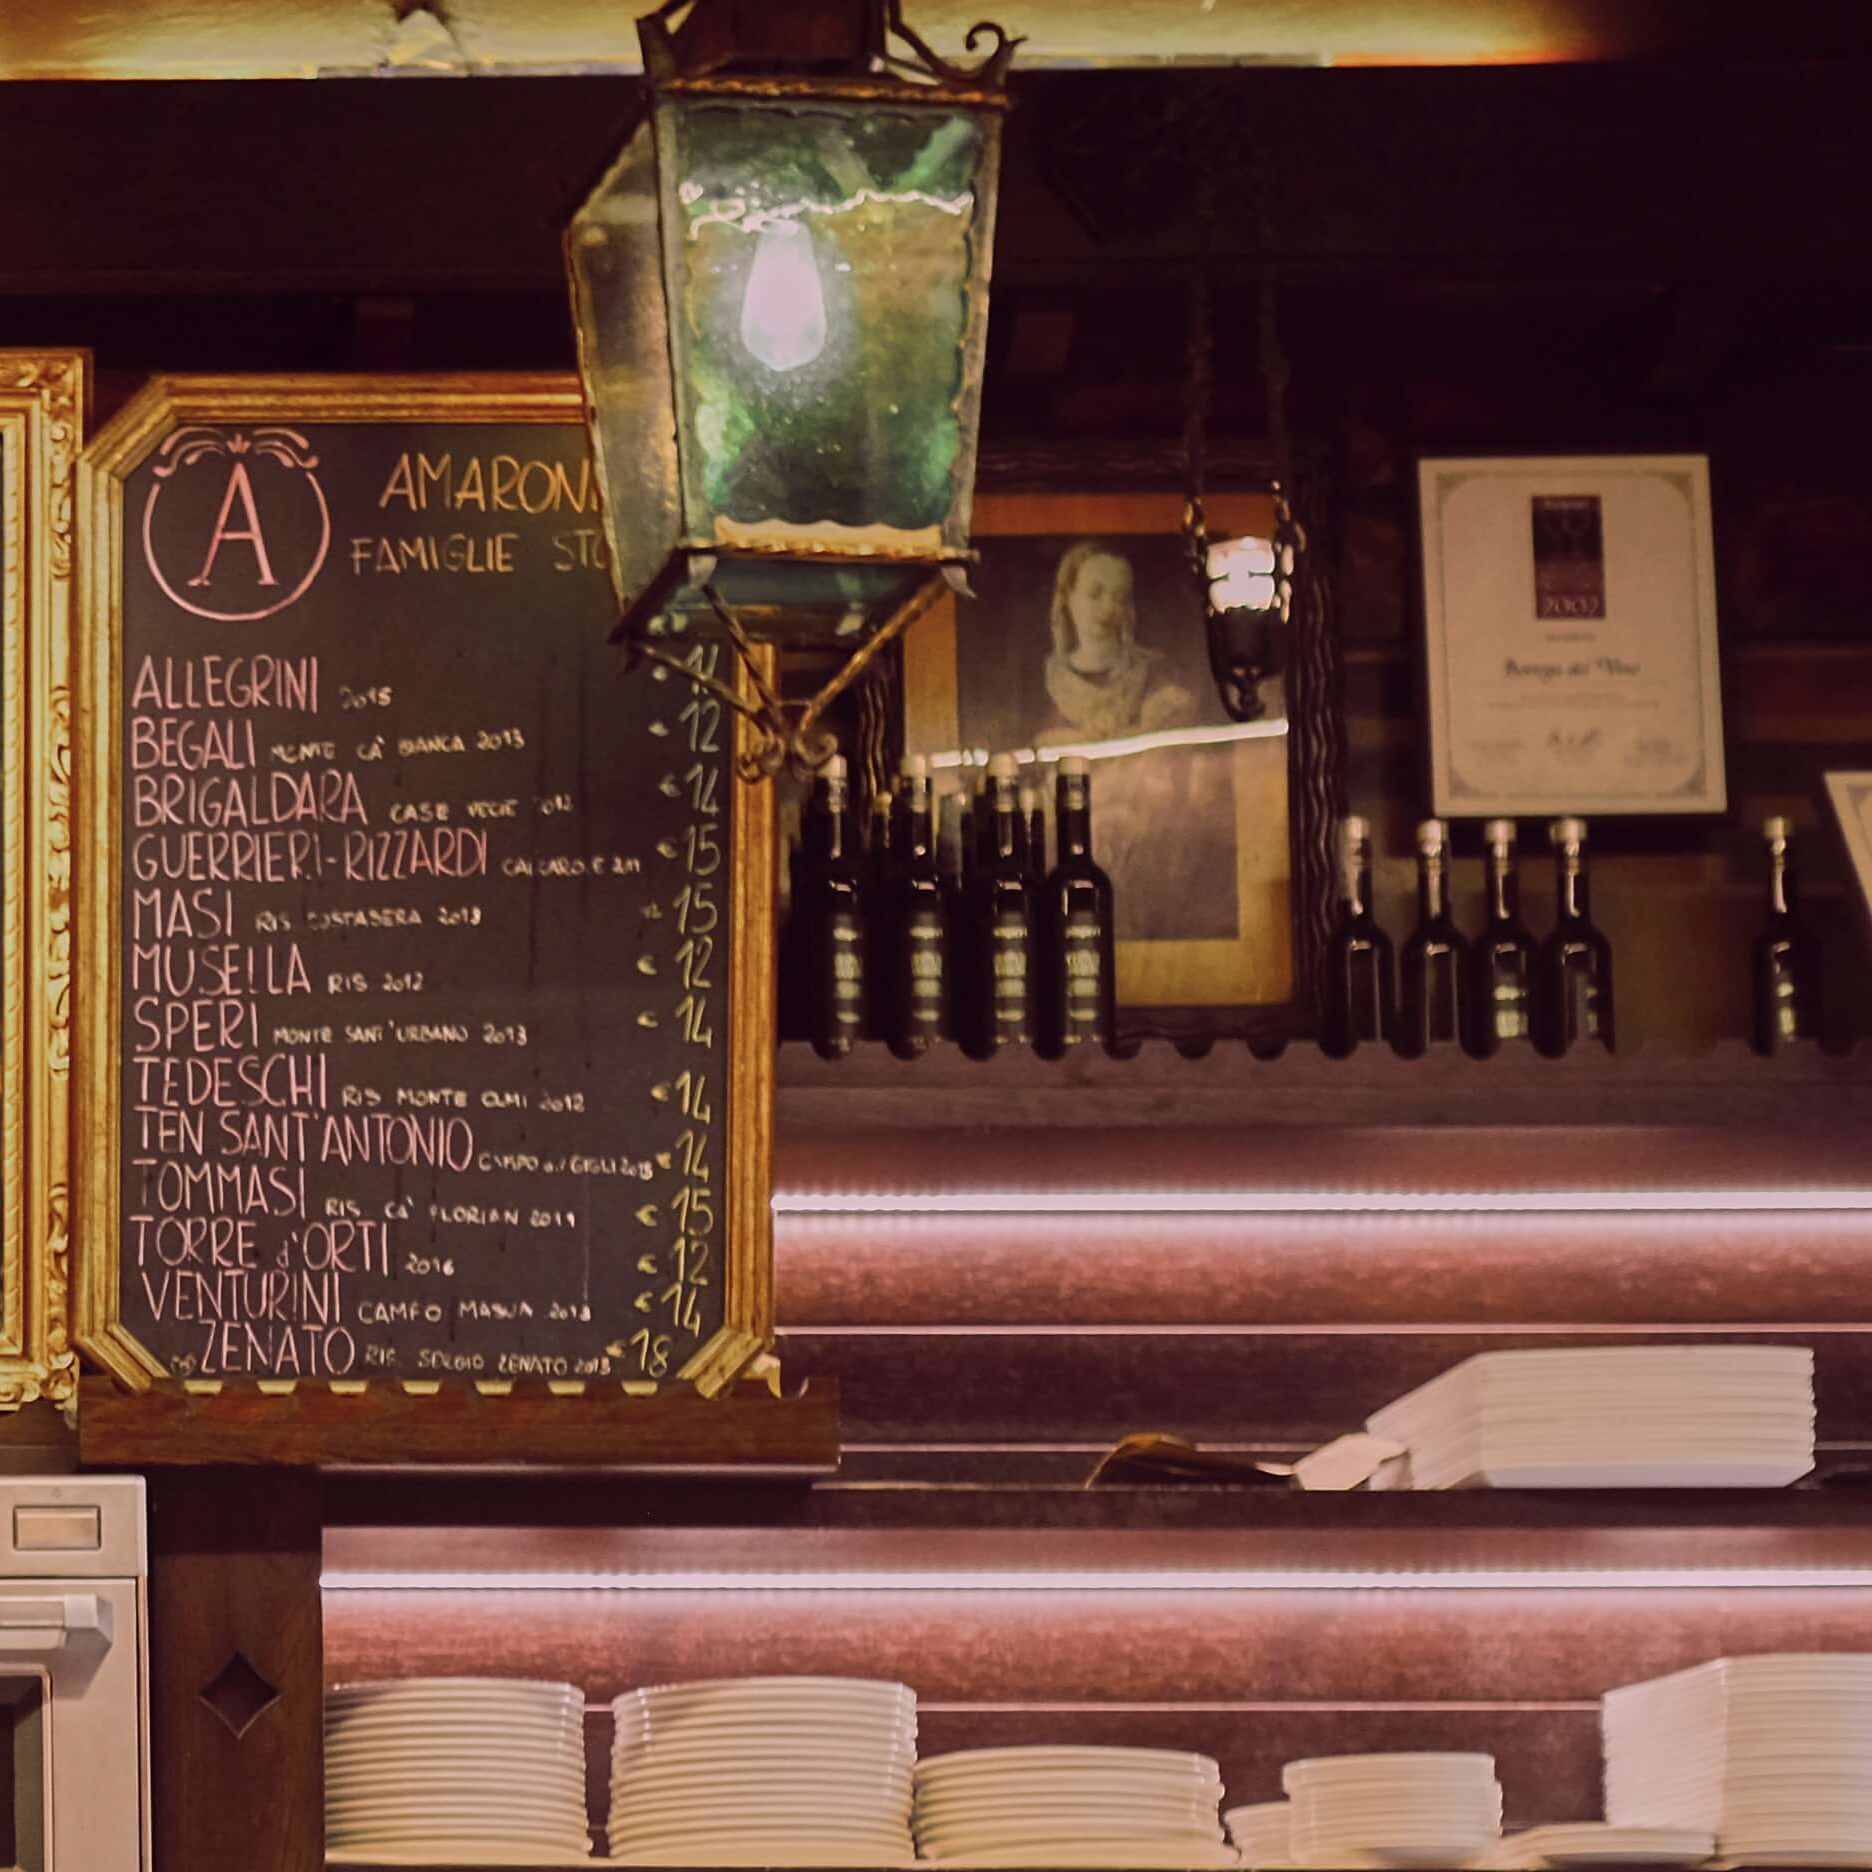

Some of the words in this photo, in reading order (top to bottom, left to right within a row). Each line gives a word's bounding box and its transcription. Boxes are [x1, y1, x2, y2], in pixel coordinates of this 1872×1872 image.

[379, 452, 596, 514] AMARON
[185, 461, 280, 587] A
[350, 535, 518, 575] FAMIGLIE
[131, 654, 318, 712] ALLEGRINI
[131, 717, 255, 770] BEGALI
[132, 770, 368, 827] BRIGALDARA
[389, 801, 449, 823] CASE
[132, 888, 232, 941] MASI
[132, 943, 311, 994] MUSELLA
[382, 971, 424, 992] 2012
[133, 998, 258, 1054] SPERI
[272, 1025, 332, 1045] MONTE
[132, 1054, 328, 1108] TEDESCHI
[395, 1087, 468, 1108] MONTE
[133, 1106, 205, 1154] TEN
[132, 1157, 305, 1218] TOMMASI
[130, 1215, 257, 1269] TORRE
[141, 1270, 341, 1323] VENTURINI
[200, 1322, 354, 1376] ZENATO
[498, 1354, 567, 1376] ZENATO
